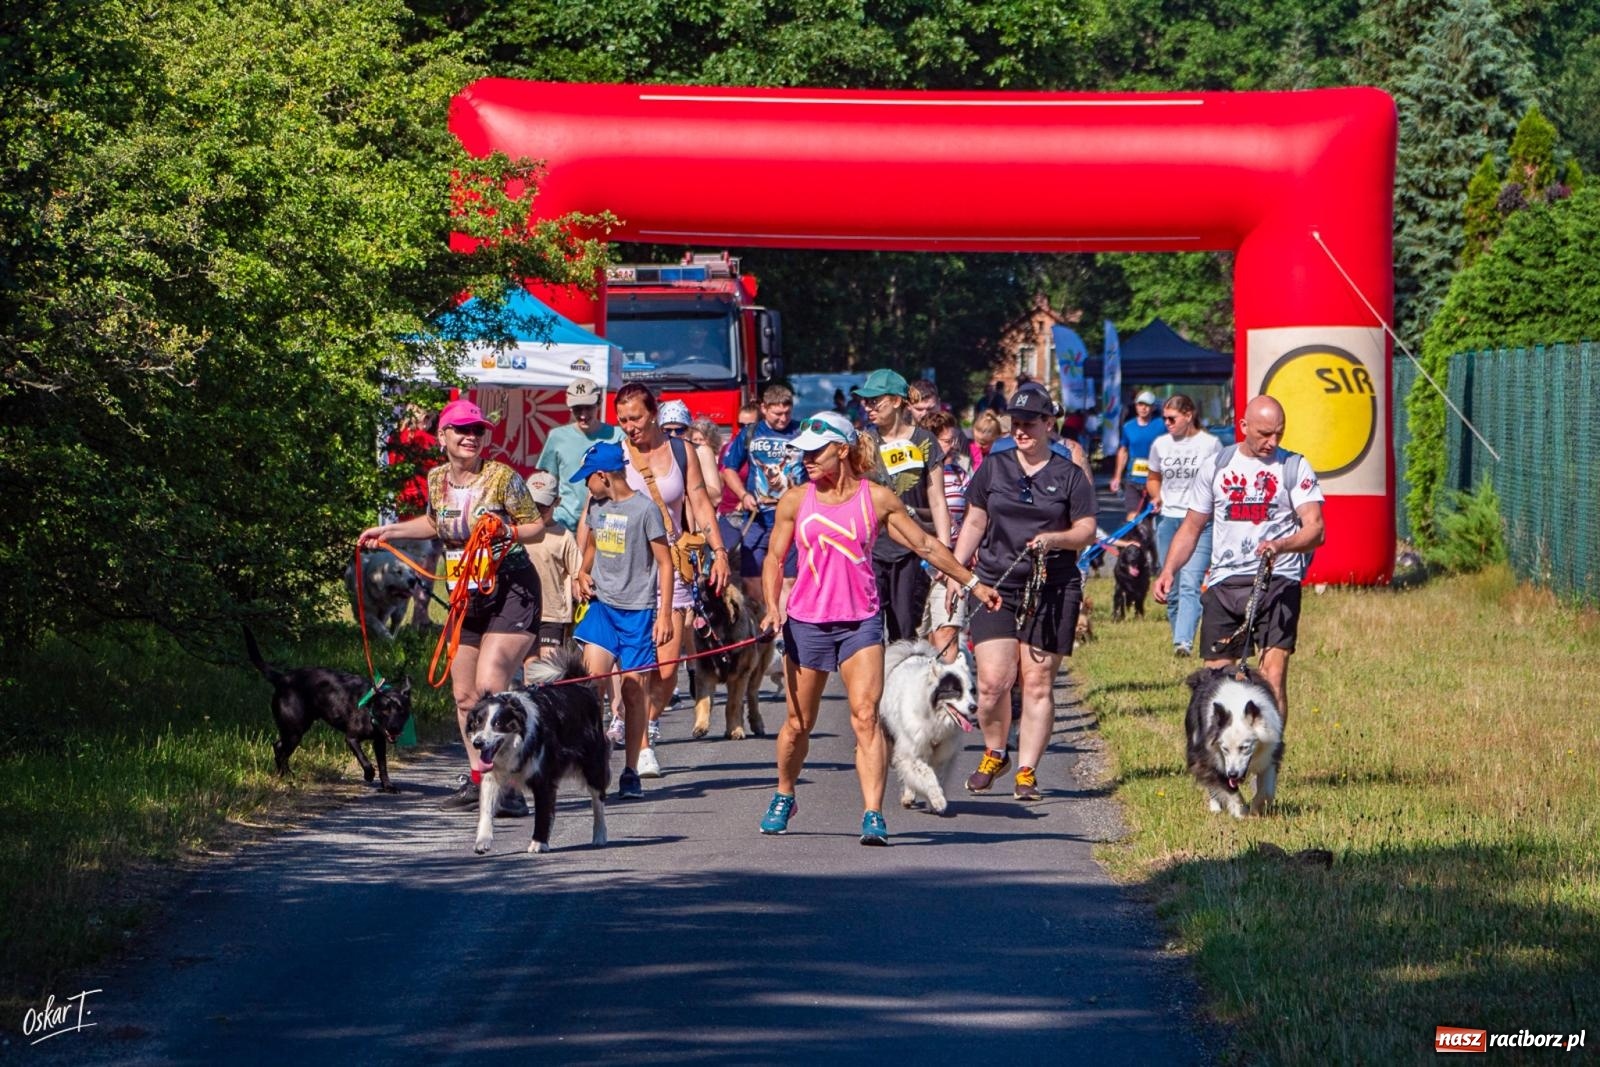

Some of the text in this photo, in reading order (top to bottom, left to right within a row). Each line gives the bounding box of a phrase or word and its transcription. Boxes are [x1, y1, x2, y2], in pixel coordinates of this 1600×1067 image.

[1315, 367, 1376, 394] SIR
[750, 441, 771, 452] BIEG
[1164, 455, 1198, 466] CAFÉ
[596, 529, 624, 545] GAME
